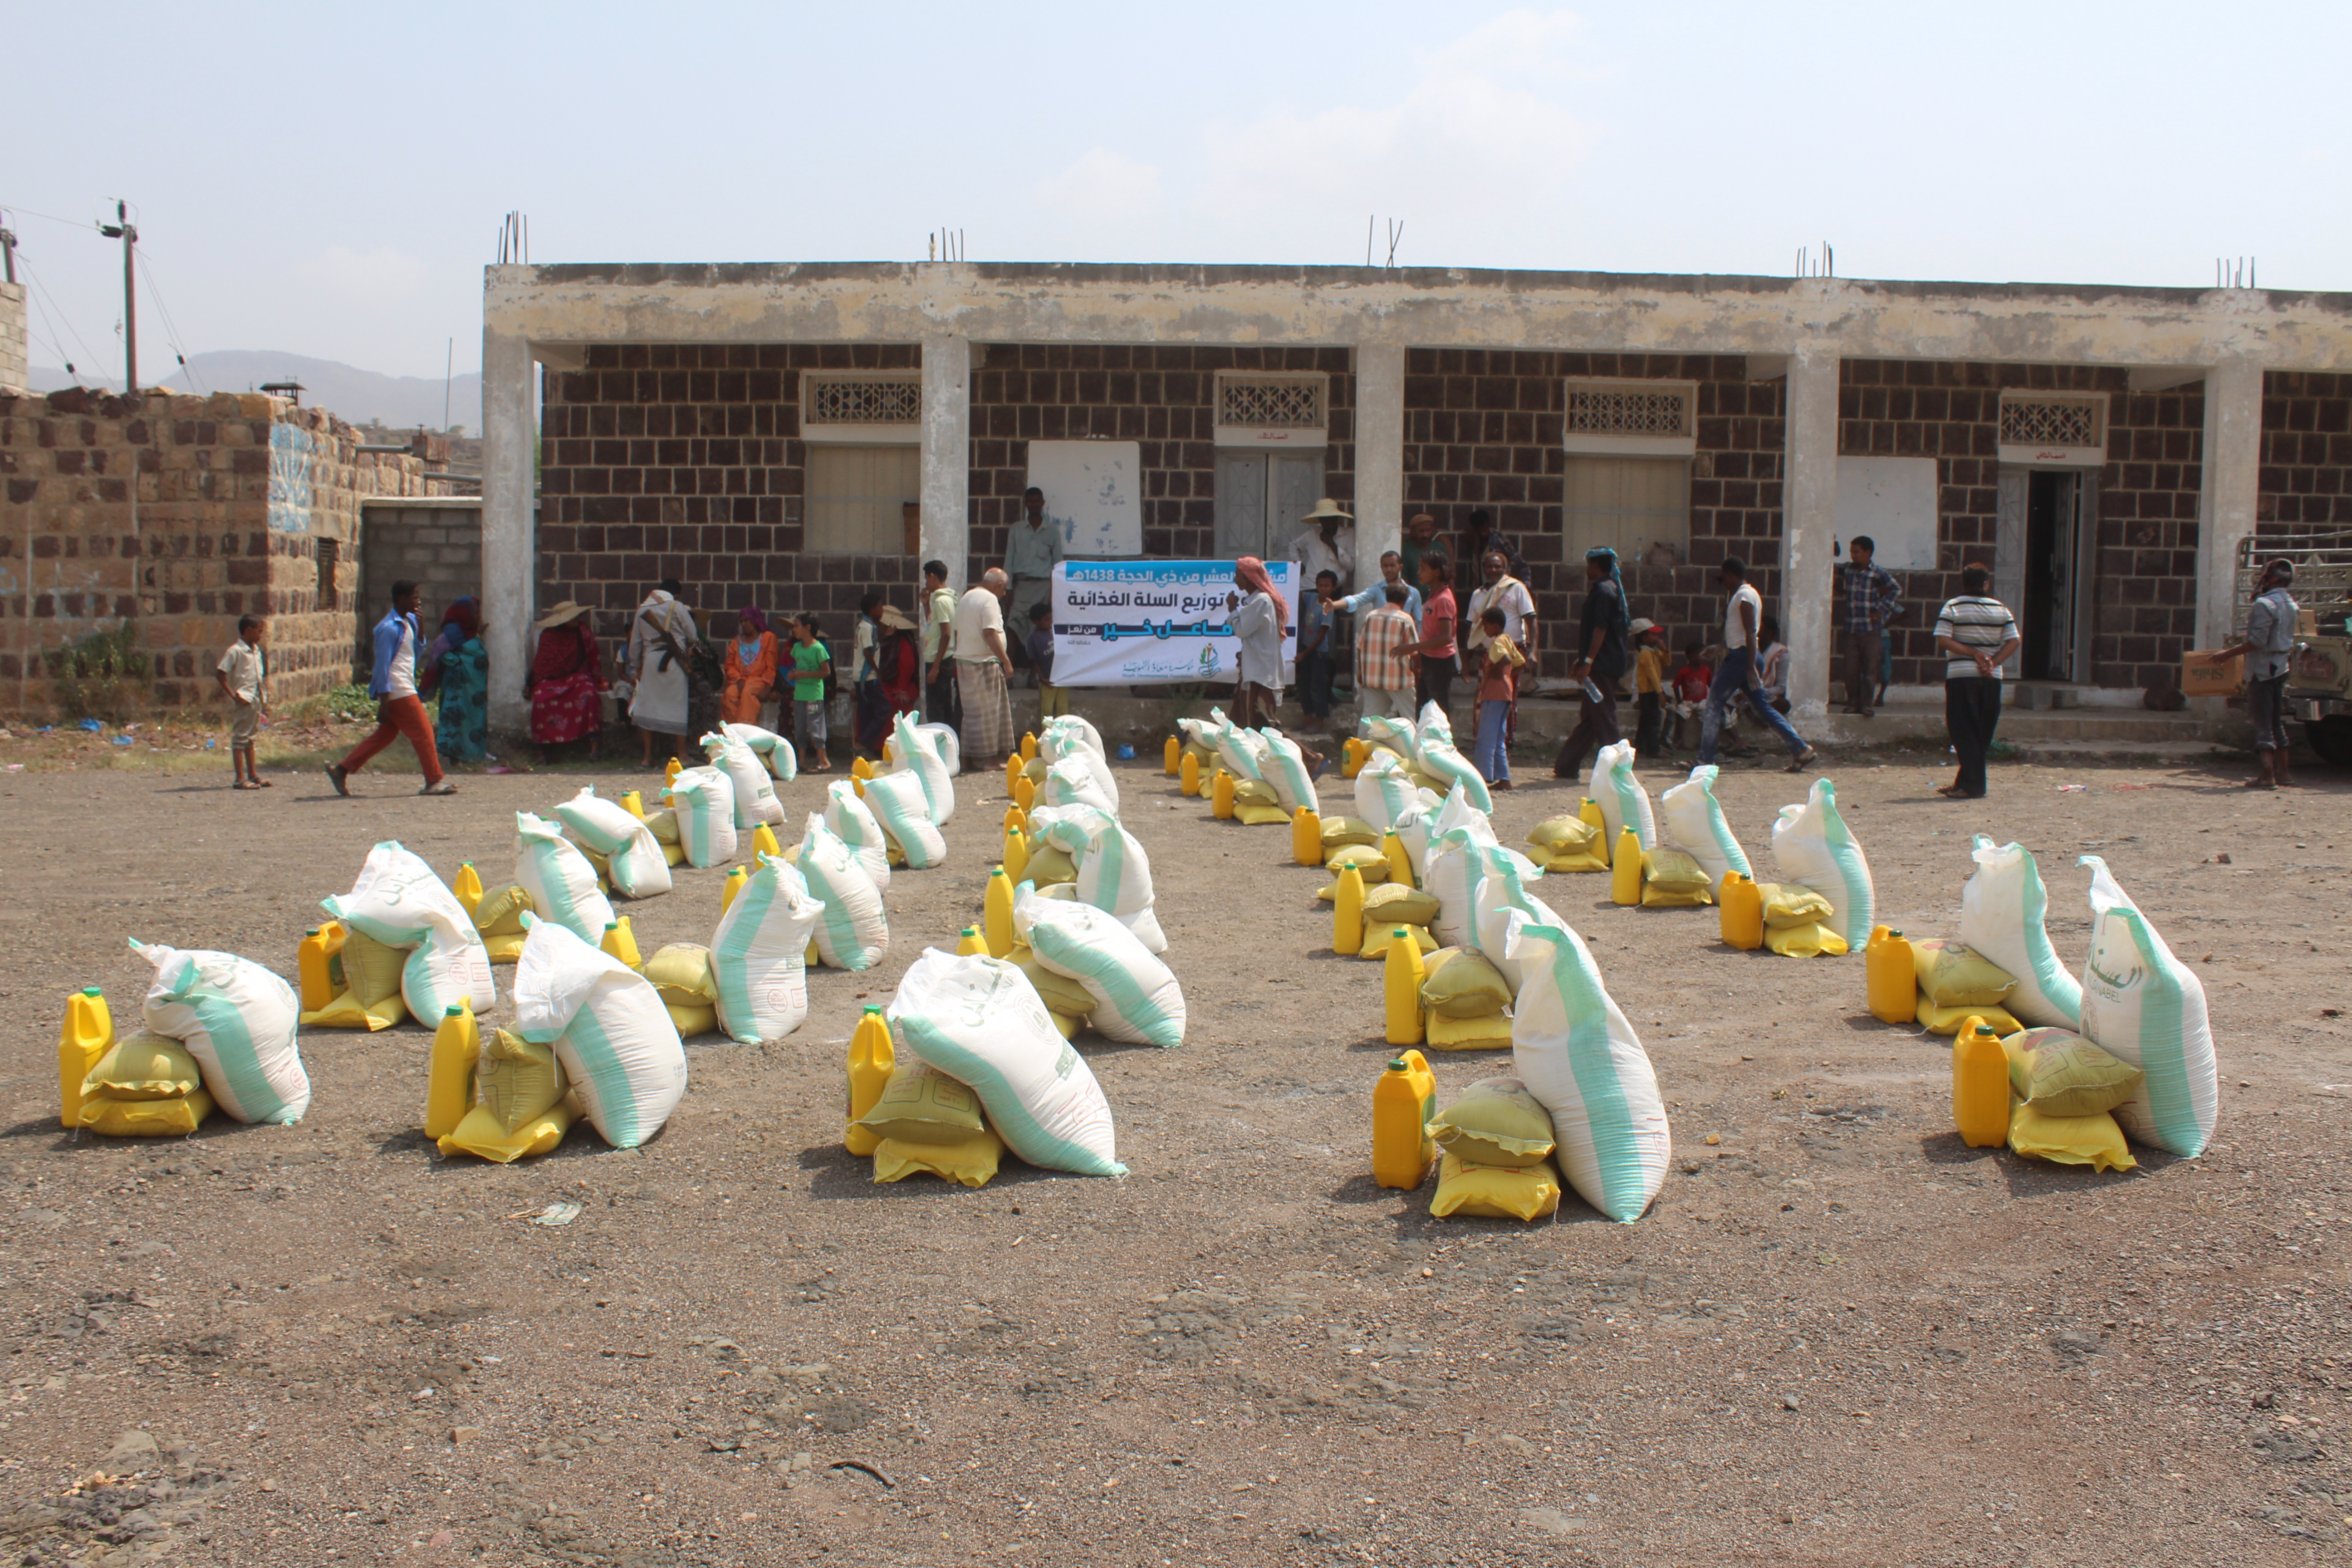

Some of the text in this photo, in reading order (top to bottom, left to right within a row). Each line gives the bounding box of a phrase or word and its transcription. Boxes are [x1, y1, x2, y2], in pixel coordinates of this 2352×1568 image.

[1117, 569, 1153, 585] الحجة
[1156, 570, 1177, 586] ذي
[1180, 573, 1200, 584] من
[1203, 568, 1236, 586] لعشر
[1068, 591, 1130, 610] الغذائية
[1134, 592, 1178, 607] السلة
[1181, 593, 1225, 613] توزيع
[2191, 668, 2225, 681] Shifa
[2039, 1041, 2087, 1056] RICE
